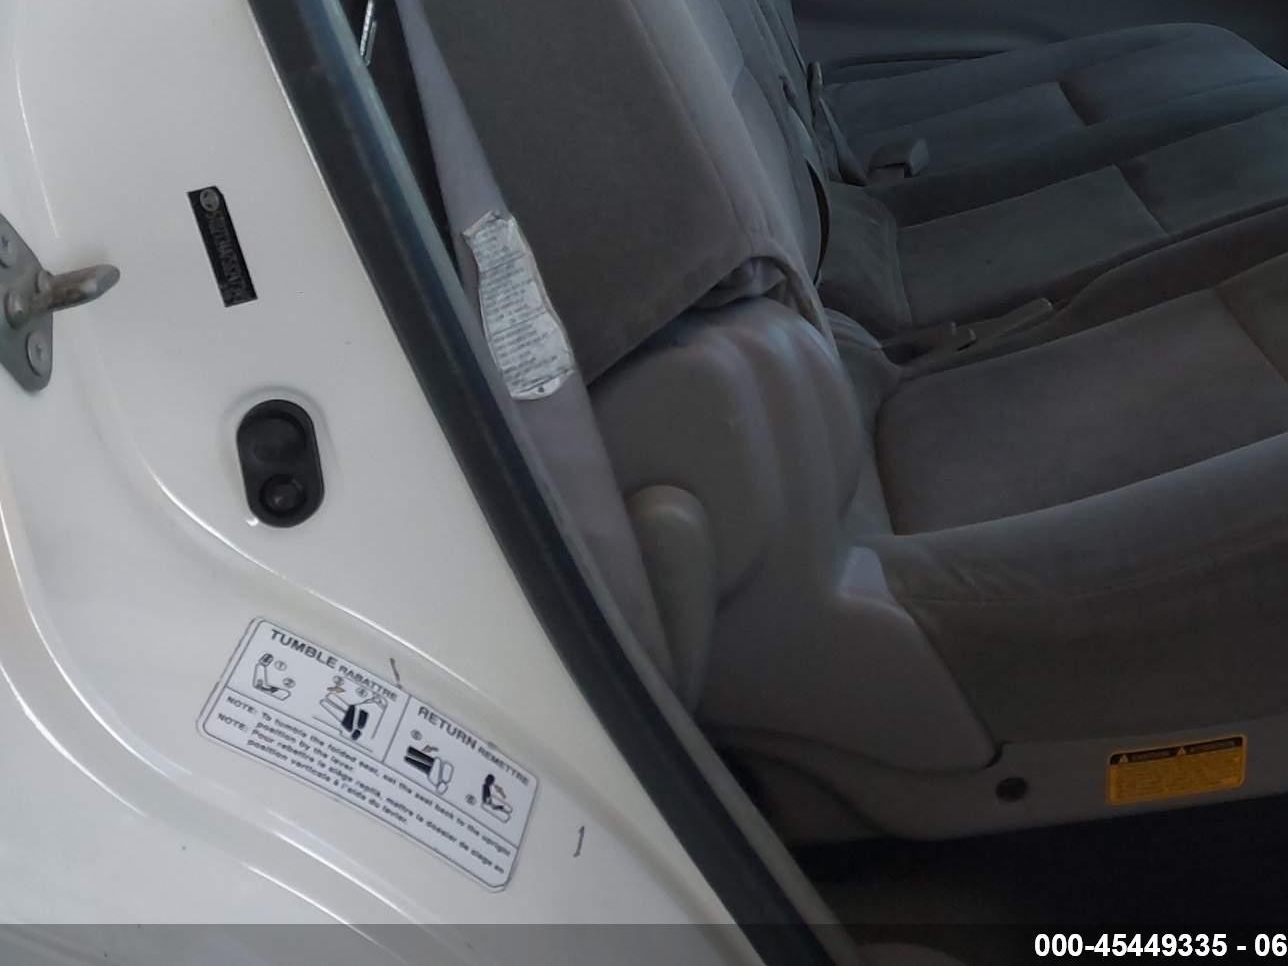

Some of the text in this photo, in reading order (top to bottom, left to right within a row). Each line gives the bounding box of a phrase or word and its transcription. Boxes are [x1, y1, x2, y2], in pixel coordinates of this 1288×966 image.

[269, 629, 399, 700] TUMBLE RABATTRE
[218, 713, 248, 732] NOTE:
[251, 729, 274, 743] Pour
[247, 739, 288, 761] position
[256, 722, 297, 743] position
[299, 740, 311, 751] by
[313, 747, 328, 758] the
[417, 706, 530, 786] RETURN REMETTRE
[226, 696, 257, 714] NOTE:
[262, 712, 272, 722] To
[275, 719, 307, 738] tumble
[310, 735, 324, 746] the
[328, 744, 357, 762] folded
[399, 782, 412, 794] the
[414, 793, 433, 806] seat
[434, 804, 454, 820] back
[467, 824, 480, 836] the
[481, 835, 511, 856] upright
